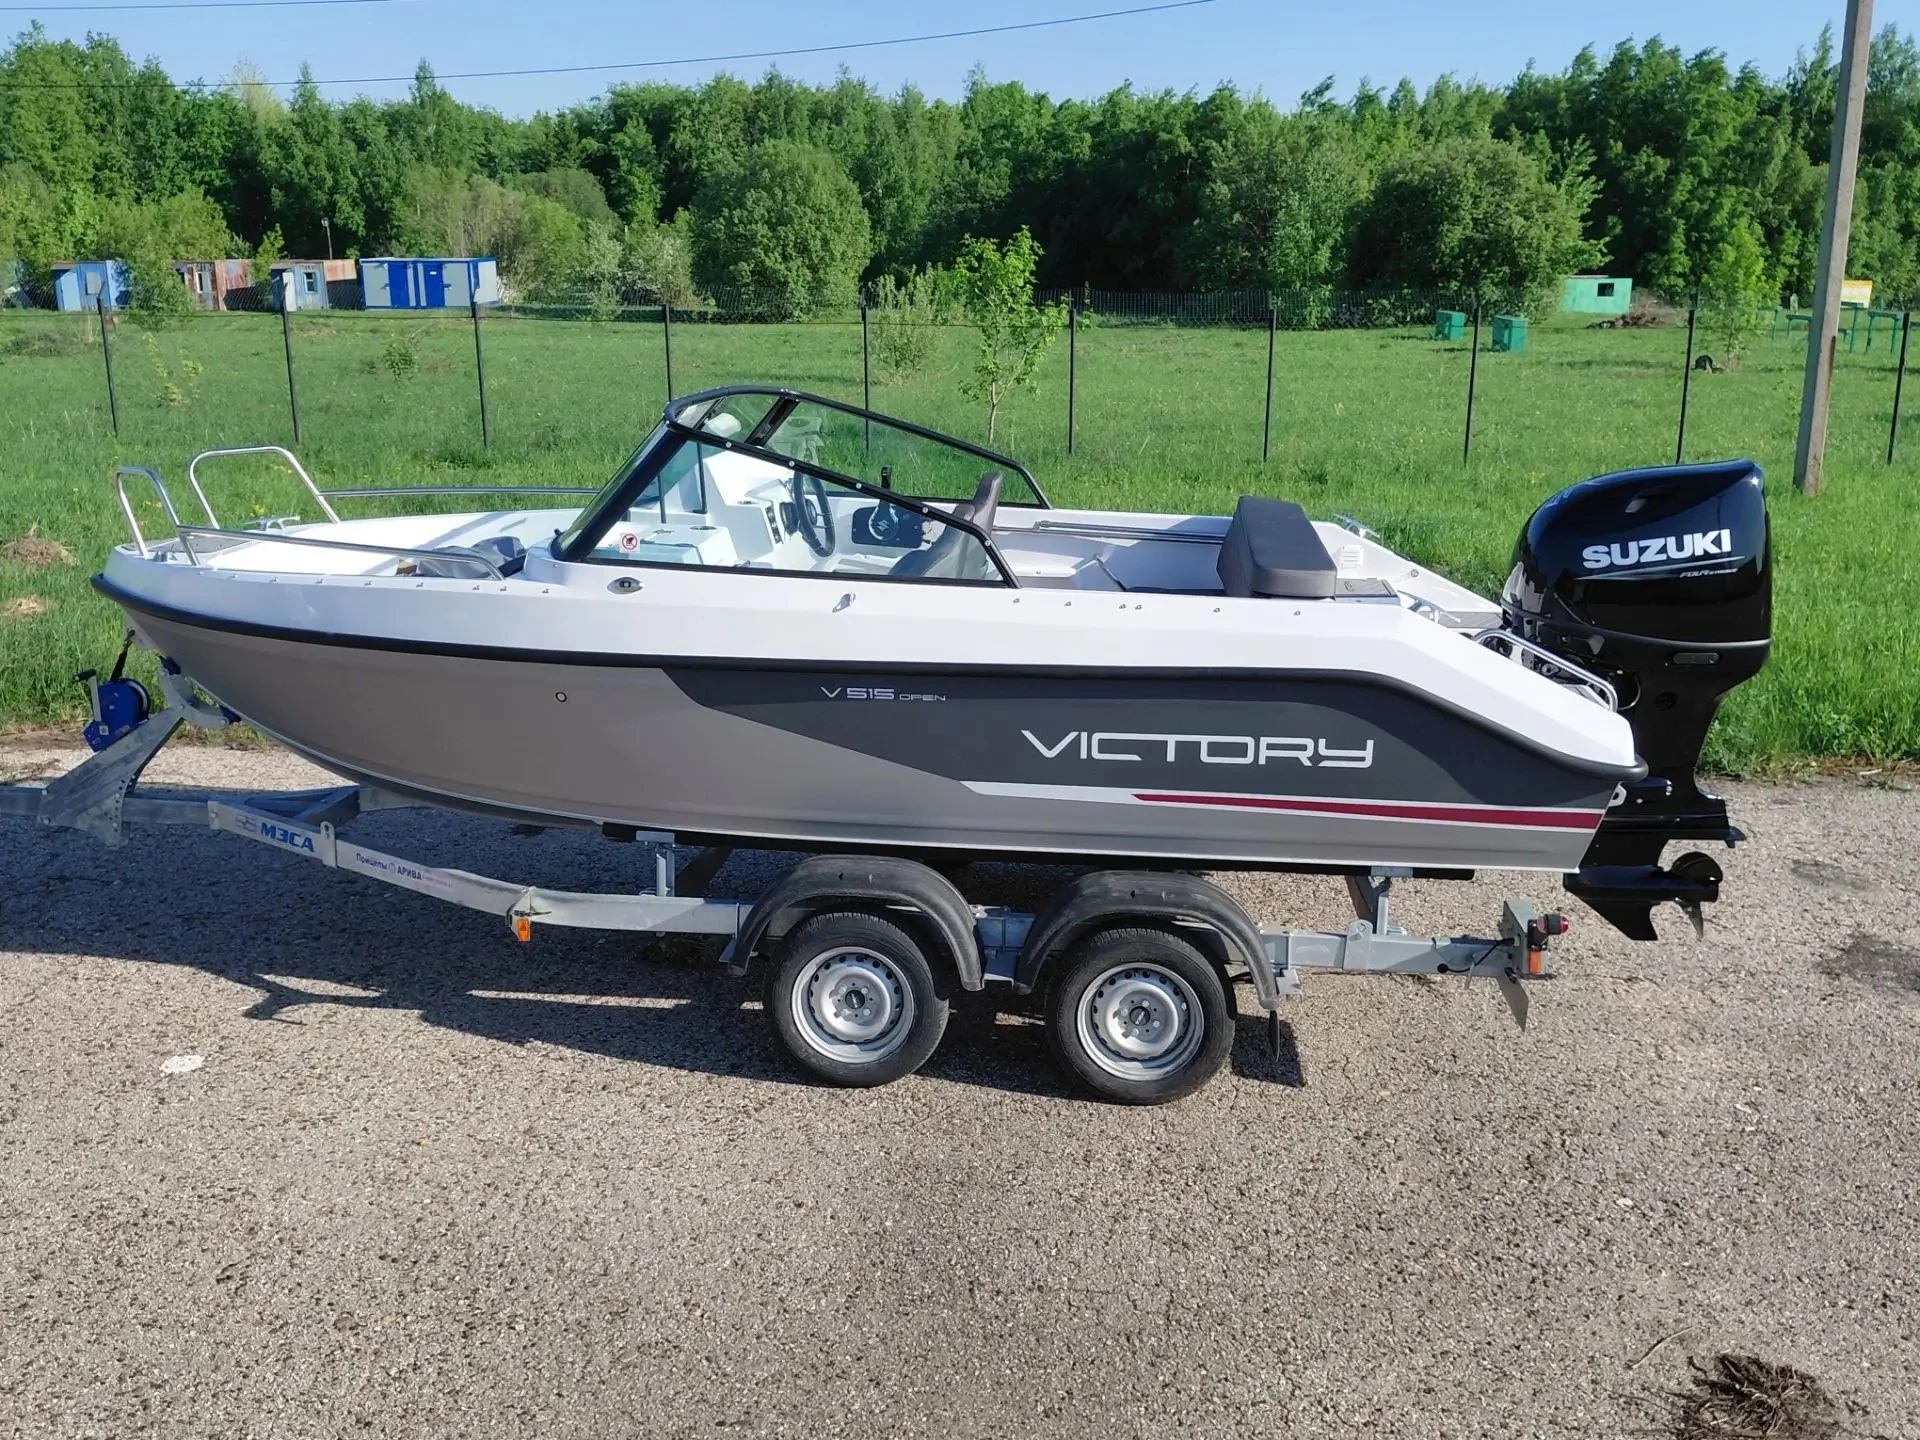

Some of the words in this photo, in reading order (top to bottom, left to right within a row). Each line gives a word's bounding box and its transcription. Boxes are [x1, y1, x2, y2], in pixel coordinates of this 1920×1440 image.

[1582, 528, 1732, 569] SUZUKI
[820, 686, 842, 699] V
[846, 687, 895, 700] 515
[899, 693, 946, 702] OPEN
[1021, 729, 1375, 769] VICTORY
[260, 822, 315, 852] МЭСА
[397, 865, 422, 881] АРИВА
